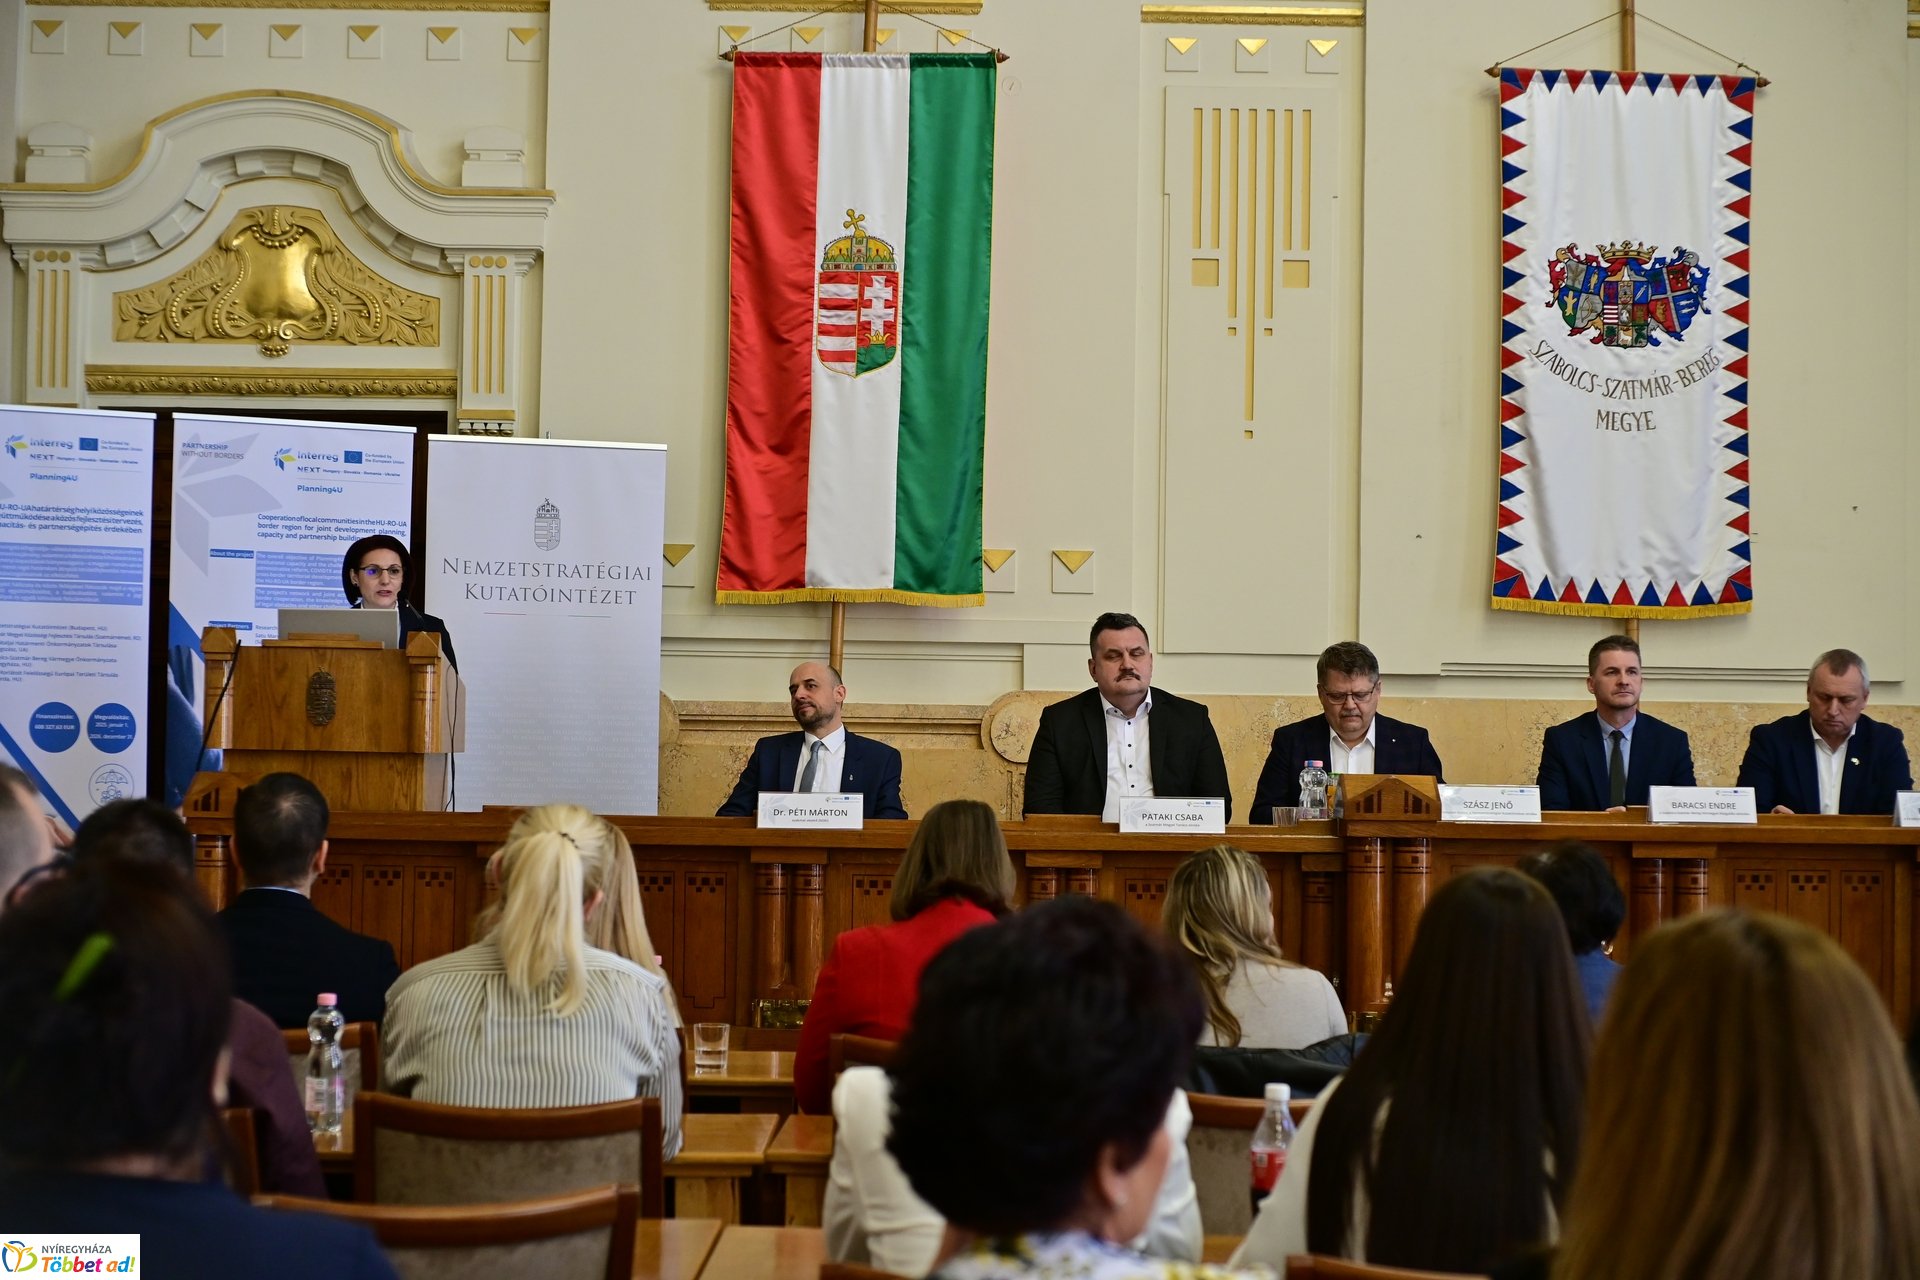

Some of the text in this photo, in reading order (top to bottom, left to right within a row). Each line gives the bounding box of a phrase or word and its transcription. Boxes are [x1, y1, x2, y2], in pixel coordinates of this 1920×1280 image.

[1528, 339, 1720, 400] SZABOLCS-SZATMÁR-BEREG
[1595, 409, 1657, 432] MEGYE
[182, 442, 228, 450] PARTNERSHIP
[181, 450, 244, 460] WITHOUT BORDERS
[30, 472, 78, 482] Planning4U
[297, 484, 343, 494] Planning4U
[257, 513, 297, 522] Cooperation
[375, 519, 407, 527] HU-RO-UA
[281, 524, 302, 532] region
[316, 525, 332, 533] joint
[334, 526, 376, 535] development
[378, 528, 407, 537] planning,
[257, 531, 284, 539] capacity
[299, 533, 338, 542] partnership
[442, 557, 652, 581] NEMZETSTRATÉGIAI
[464, 583, 637, 605] KUTATÓINTÉZET
[1463, 800, 1514, 810] SZÁSZ JENŐ
[1672, 801, 1737, 810] BARACSI ENDRE
[773, 807, 848, 817] Dr. PÉTI MÁRTON
[1142, 813, 1204, 821] PATAKI CSABA
